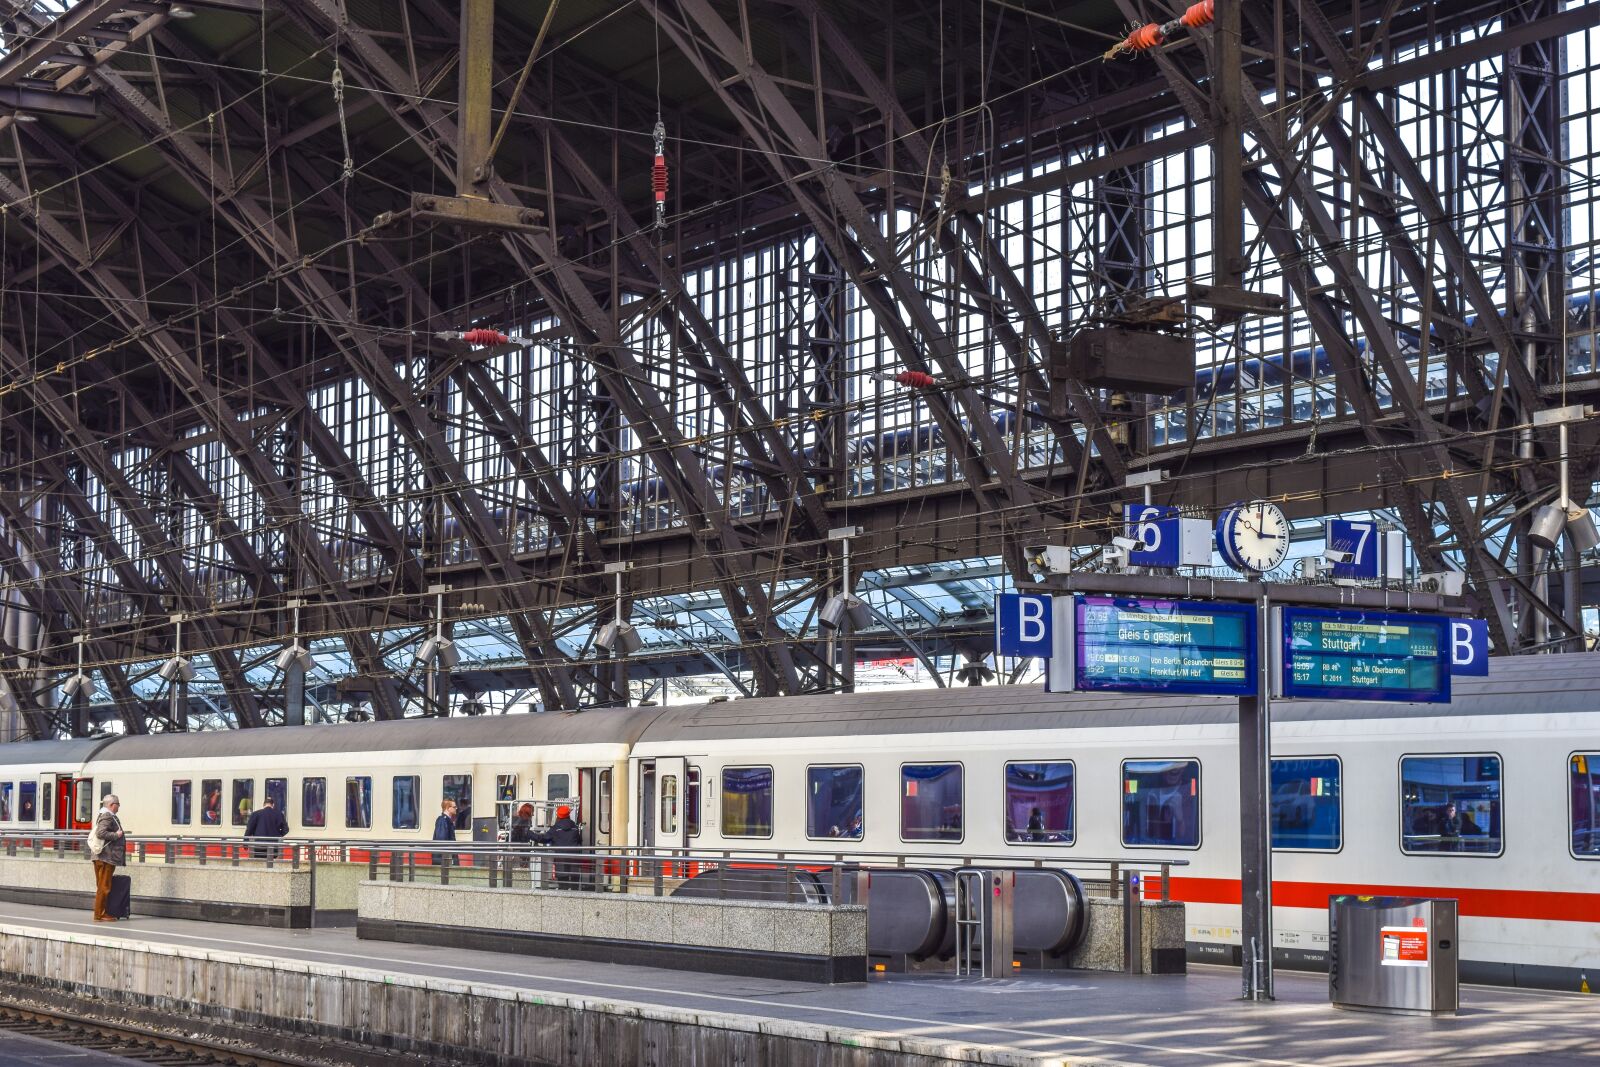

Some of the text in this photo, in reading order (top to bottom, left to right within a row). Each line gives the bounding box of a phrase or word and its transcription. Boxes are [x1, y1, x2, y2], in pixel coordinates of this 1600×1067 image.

[1139, 507, 1161, 552] 6
[1350, 523, 1371, 565] 7
[1019, 597, 1045, 642] B
[1293, 622, 1312, 631] 14:53
[1119, 628, 1191, 644] Gleis 6 gesperrt
[1452, 622, 1474, 665] B
[1322, 638, 1360, 652] Stuttgart
[1151, 667, 1188, 677] Frankfurt/M
[1190, 669, 1201, 677] Hbf
[1294, 662, 1309, 670] 15:05
[1371, 665, 1406, 674] Oberbarmen
[1294, 673, 1309, 681] 15:17
[1352, 675, 1377, 685] Stuttgart
[529, 780, 534, 798] 1
[707, 778, 713, 797] 1
